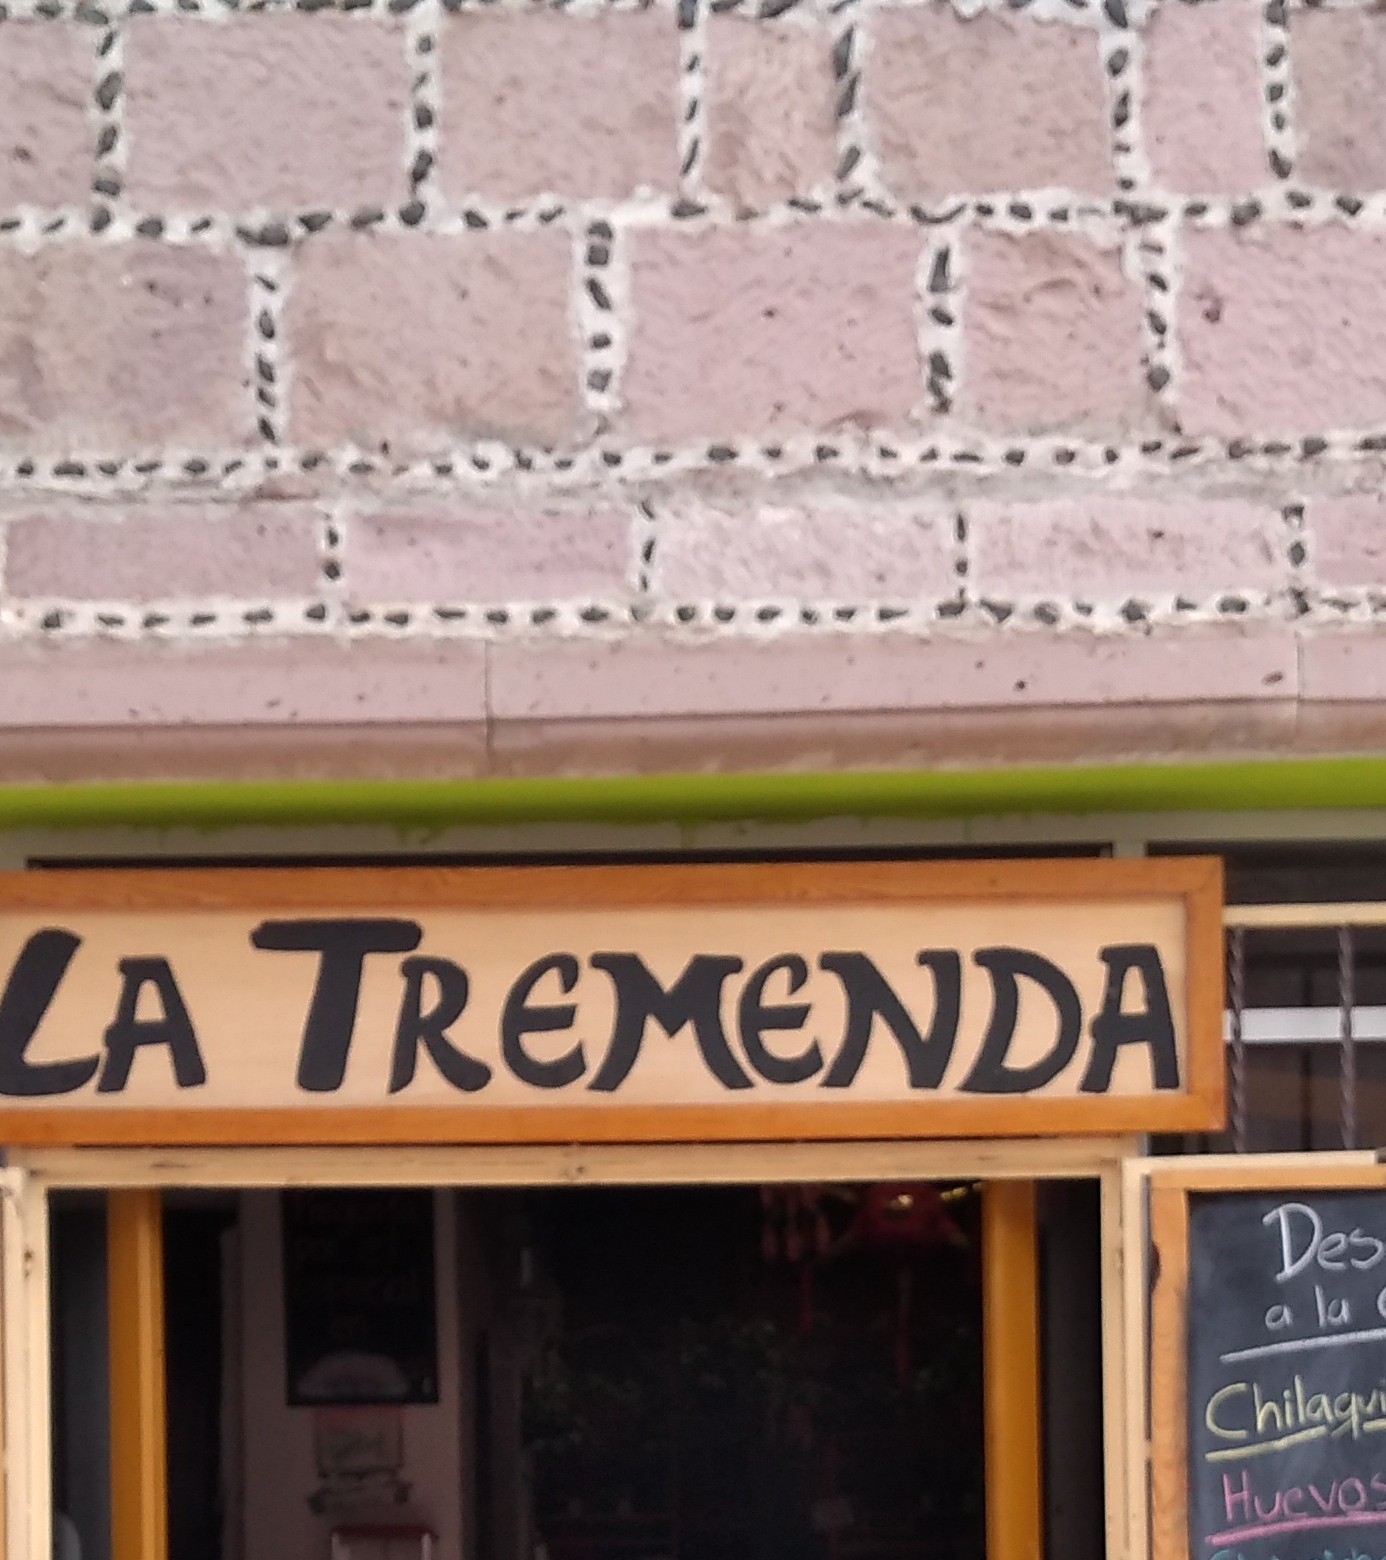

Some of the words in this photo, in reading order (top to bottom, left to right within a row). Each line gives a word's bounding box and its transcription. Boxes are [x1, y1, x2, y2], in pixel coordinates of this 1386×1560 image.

[250, 917, 1181, 1096] TREMENDA
[1265, 1301, 1293, 1331] a
[1314, 1285, 1352, 1328] la
